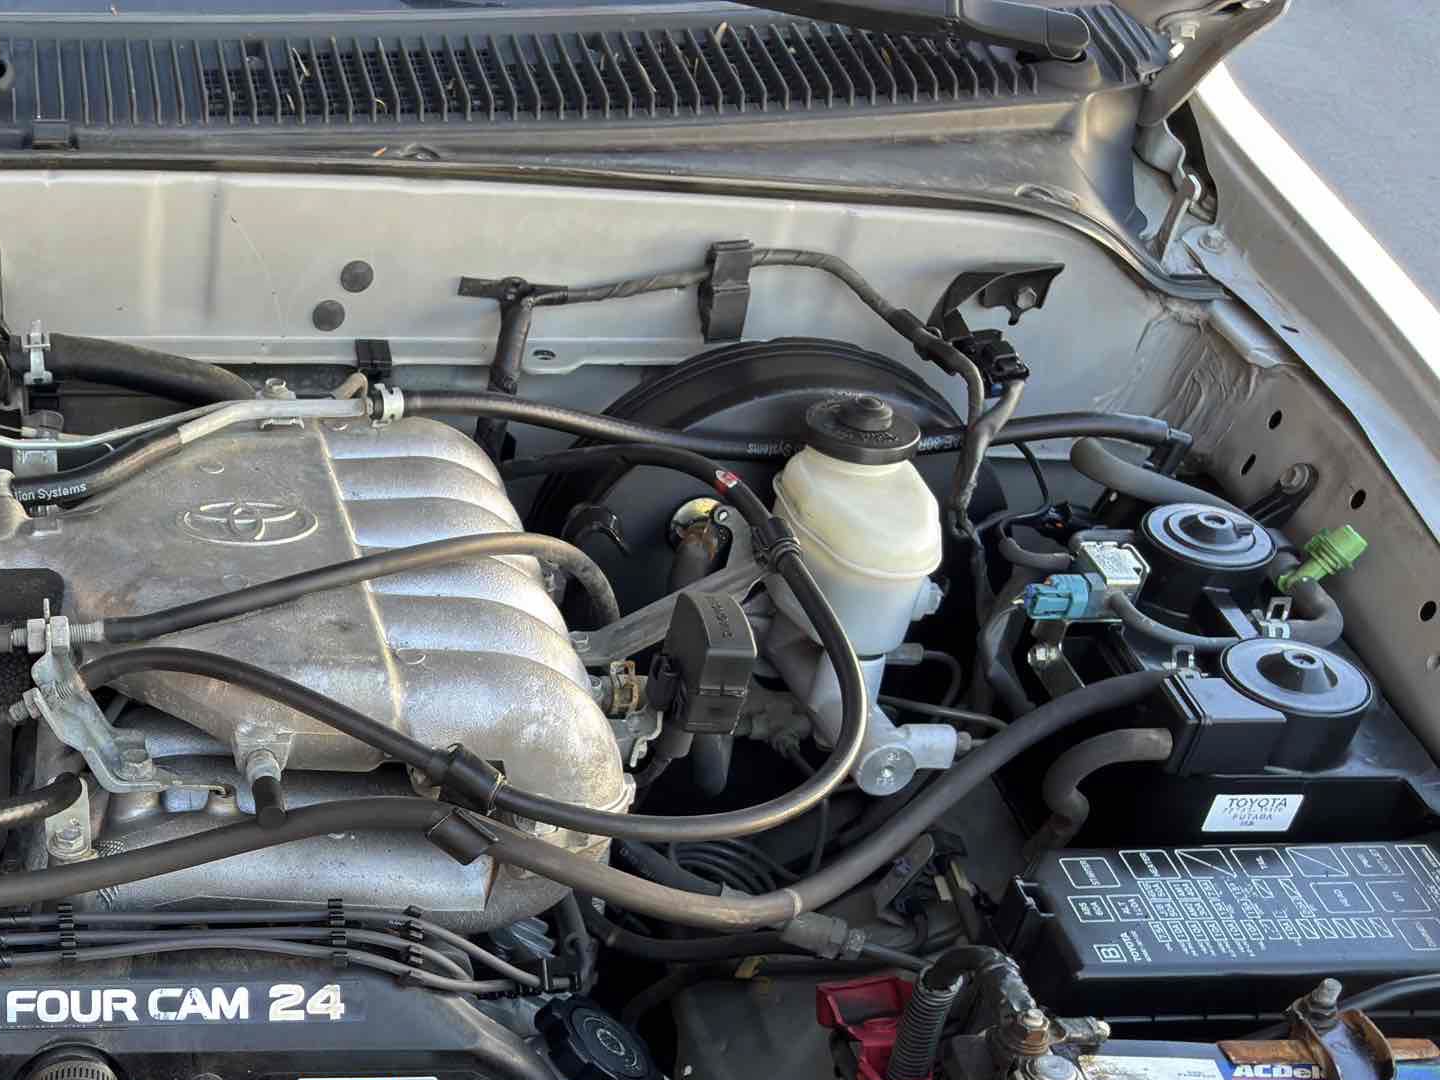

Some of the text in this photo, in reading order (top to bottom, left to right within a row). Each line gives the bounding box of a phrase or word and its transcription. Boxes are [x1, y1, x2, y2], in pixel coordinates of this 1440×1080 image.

[38, 482, 87, 501] Systems
[1228, 798, 1287, 808] TOYOTA
[1101, 946, 1121, 960] B
[1121, 931, 1141, 962] TOYOTA
[6, 989, 139, 1024] FOUR
[147, 987, 249, 1021] CAM
[268, 984, 346, 1021] 24
